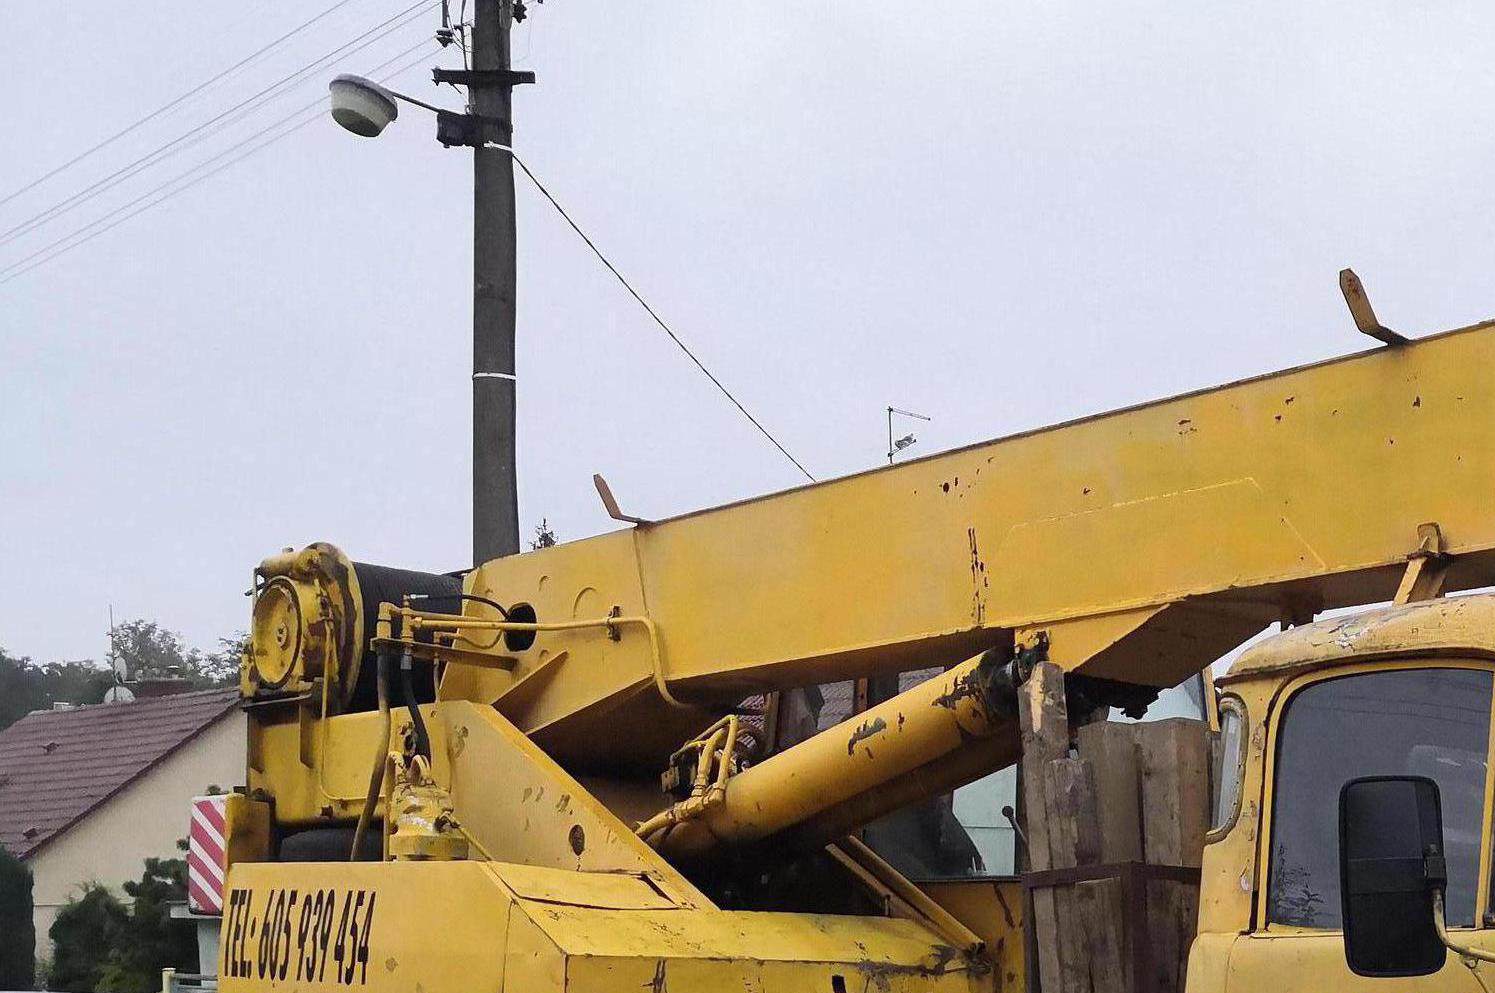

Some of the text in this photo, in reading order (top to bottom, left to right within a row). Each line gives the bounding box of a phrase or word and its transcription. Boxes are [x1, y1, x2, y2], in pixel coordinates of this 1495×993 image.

[224, 888, 377, 986] TEL: 605 939 454
